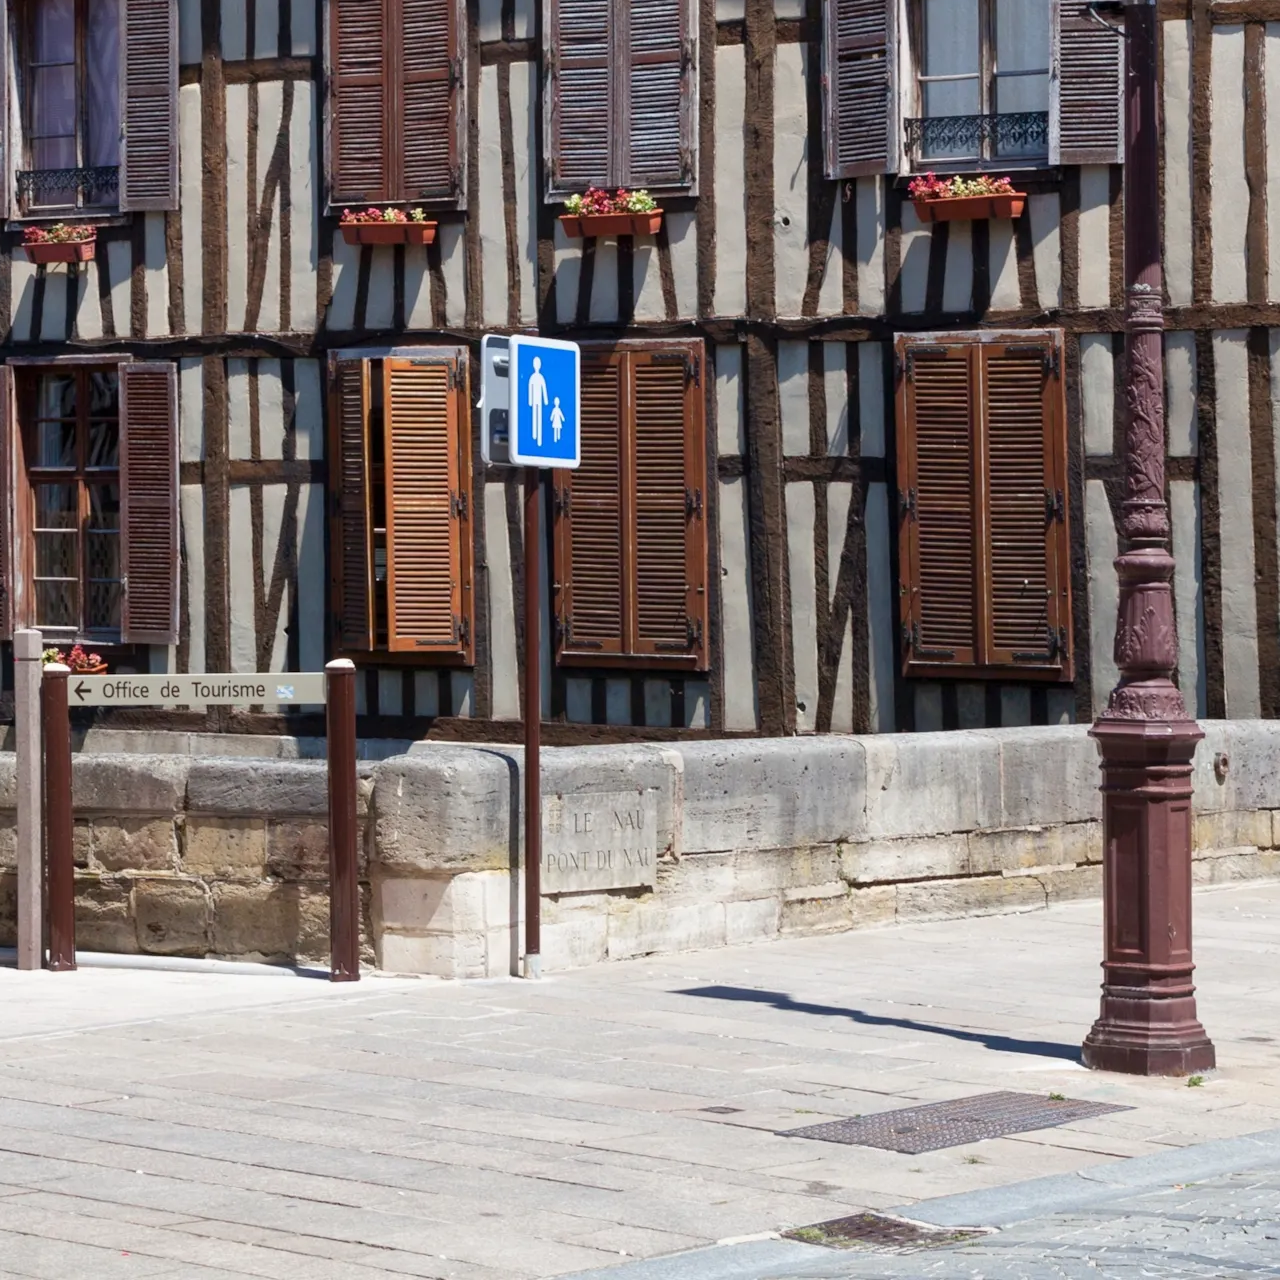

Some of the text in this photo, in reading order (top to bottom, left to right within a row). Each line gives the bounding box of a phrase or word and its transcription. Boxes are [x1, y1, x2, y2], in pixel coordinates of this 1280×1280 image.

[102, 680, 266, 699] Office de Tourisme
[573, 808, 645, 833] LE NAU
[547, 846, 653, 873] PONT DU NAU
